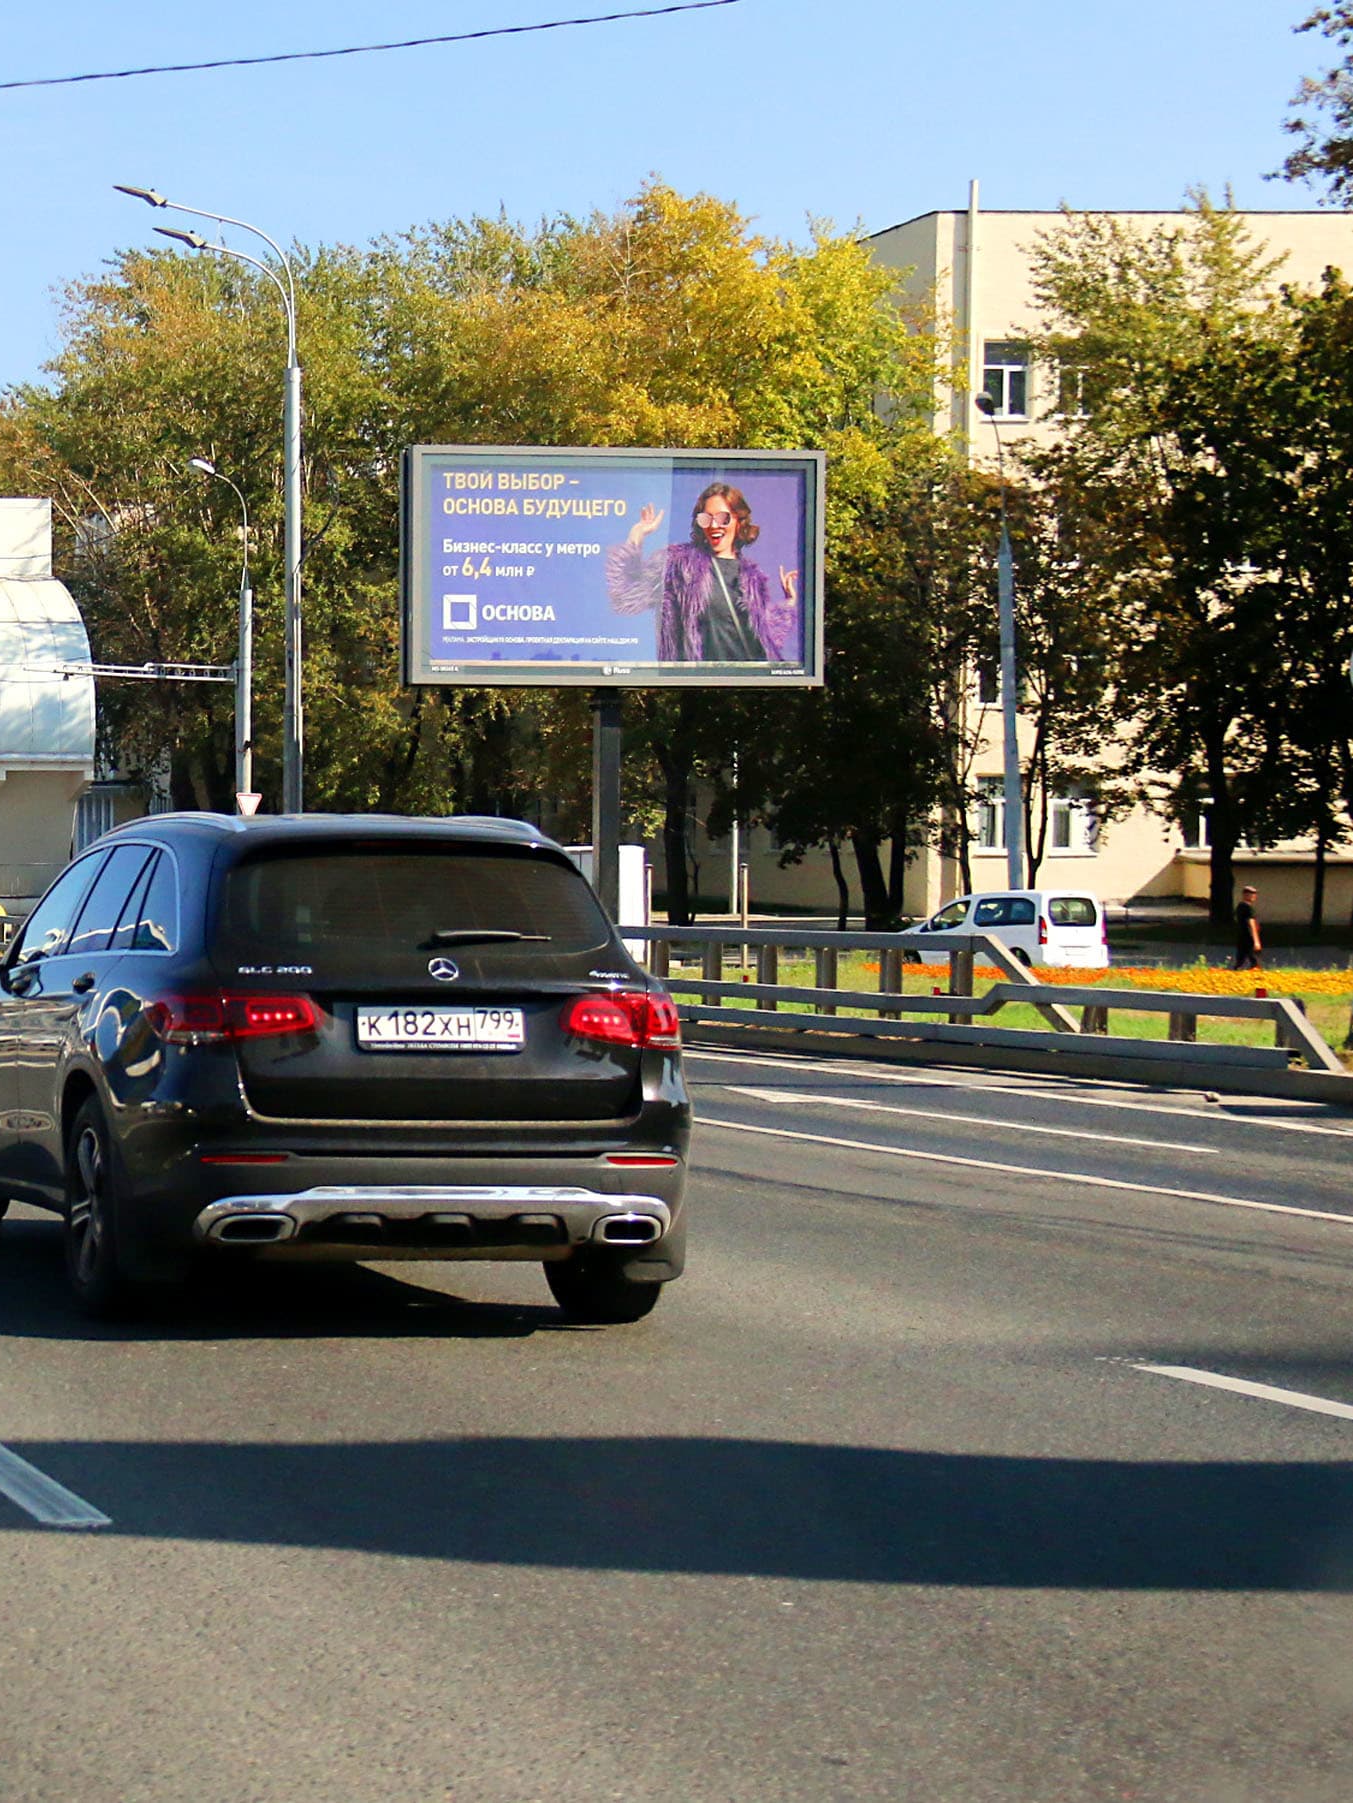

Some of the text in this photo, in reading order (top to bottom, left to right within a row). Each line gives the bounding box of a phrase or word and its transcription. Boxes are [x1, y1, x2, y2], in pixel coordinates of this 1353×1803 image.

[442, 470, 492, 490] ТВОЙ
[498, 473, 565, 491] ВЫБОР
[442, 497, 627, 519] ОСНОВА БУДУЩЕГО
[442, 538, 601, 559] Бизнес-класс у метро
[442, 565, 459, 577] от
[461, 556, 493, 580] 6,4
[495, 565, 523, 577] млн
[481, 604, 557, 622] ОСНОВА
